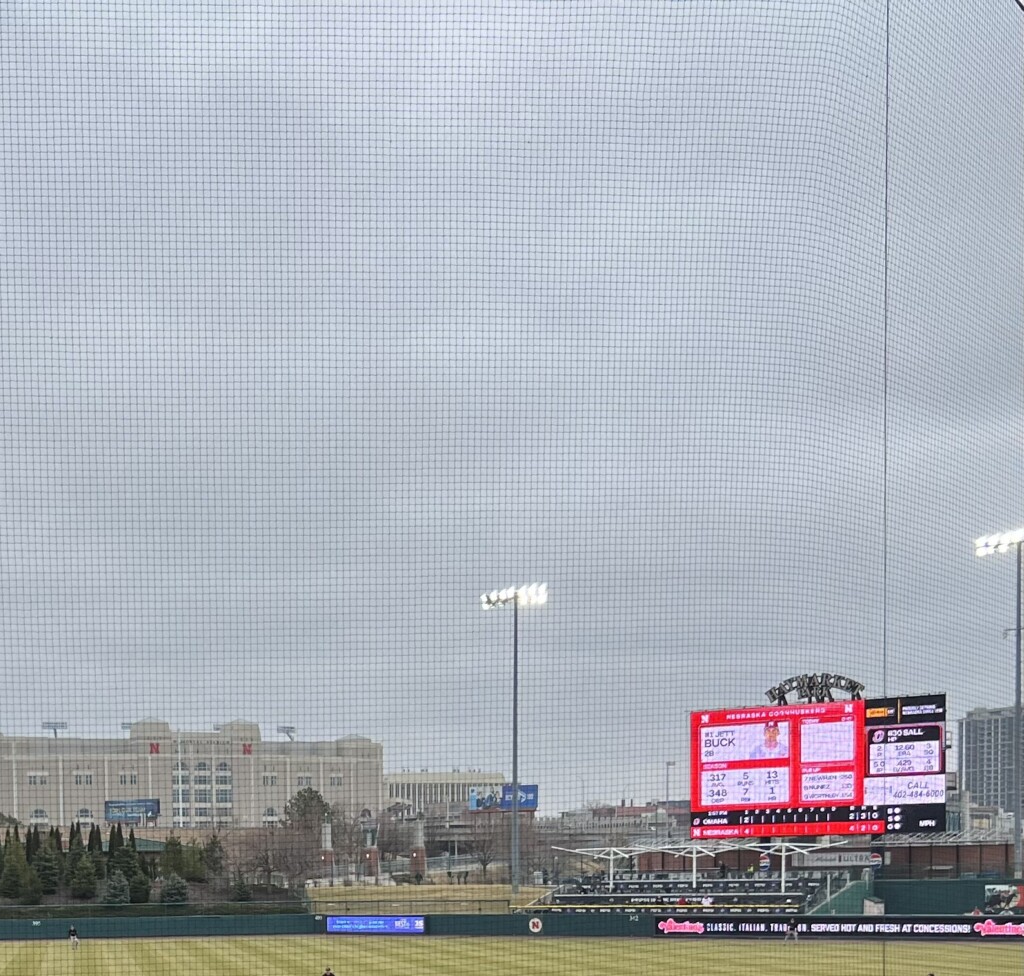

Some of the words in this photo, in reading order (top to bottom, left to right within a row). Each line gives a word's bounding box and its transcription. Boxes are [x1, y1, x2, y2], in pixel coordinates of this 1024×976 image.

[765, 673, 865, 703] HAYMARKET
[798, 687, 832, 699] PARK
[726, 712, 766, 720] NEBRASKA
[150, 743, 159, 754] N
[704, 738, 736, 748] BUCK
[243, 743, 252, 755] N
[707, 773, 726, 782] .317
[743, 772, 749, 780] 5
[767, 770, 778, 779] 13
[706, 789, 728, 798] .348
[769, 787, 776, 795] 1
[702, 828, 739, 836] NEBRASKA
[532, 921, 539, 929] N
[811, 924, 840, 932] SERVED
[841, 924, 856, 932] HOT
[857, 924, 874, 932] AND
[875, 924, 900, 933] FRESH
[902, 924, 912, 933] AT
[913, 924, 971, 933] CONCESSIONS!
